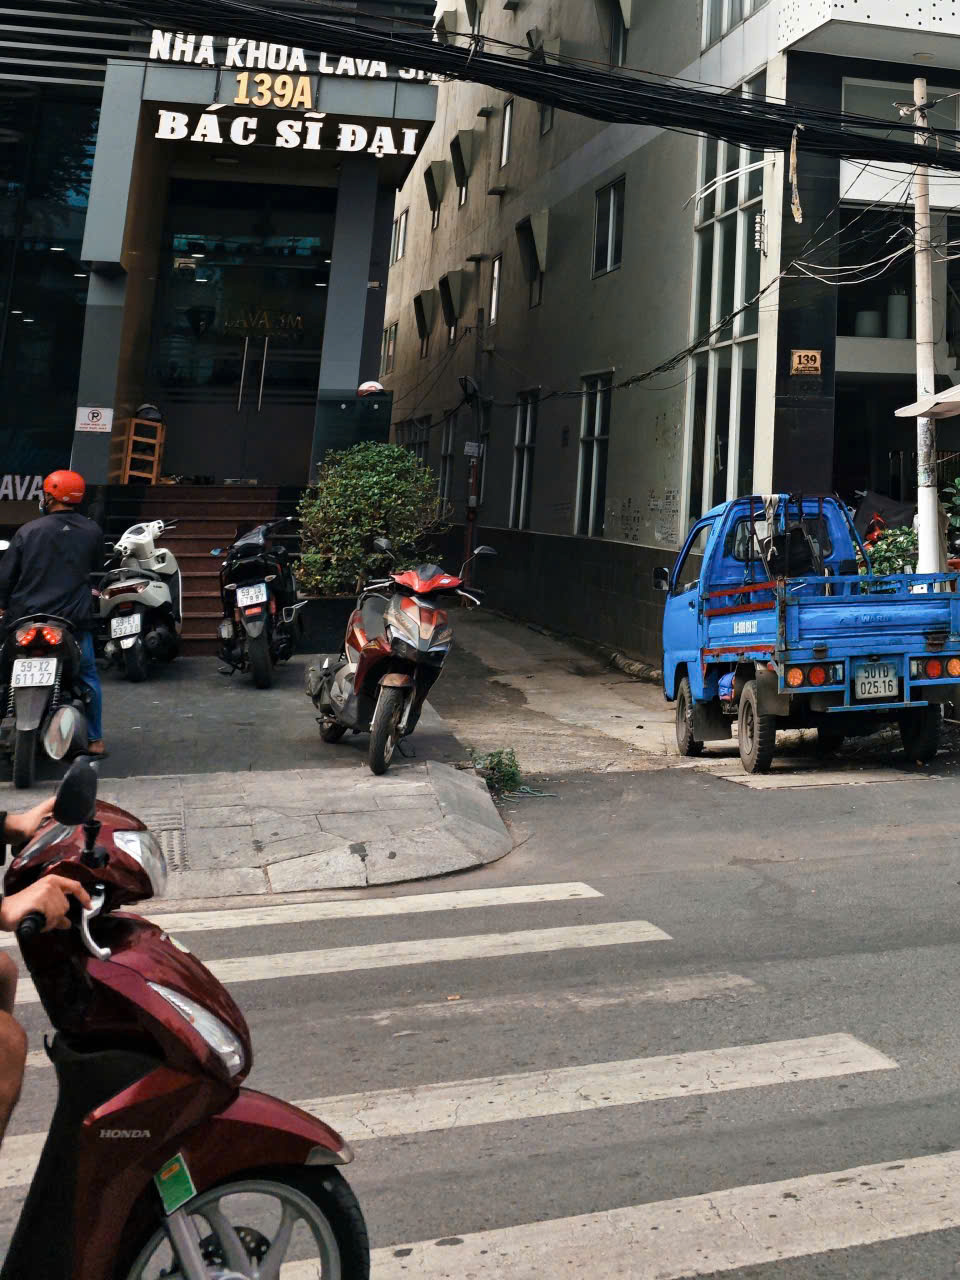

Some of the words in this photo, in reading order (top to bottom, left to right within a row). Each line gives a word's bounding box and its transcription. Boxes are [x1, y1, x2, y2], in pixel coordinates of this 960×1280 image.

[149, 29, 215, 65] NHA
[225, 37, 308, 71] KHOA
[233, 71, 313, 109] 139A
[154, 103, 258, 145] BÁC
[275, 111, 327, 150] SĨ
[336, 123, 419, 158] ĐẠI
[797, 354, 817, 366] 139
[100, 1129, 151, 1139] HONDA
